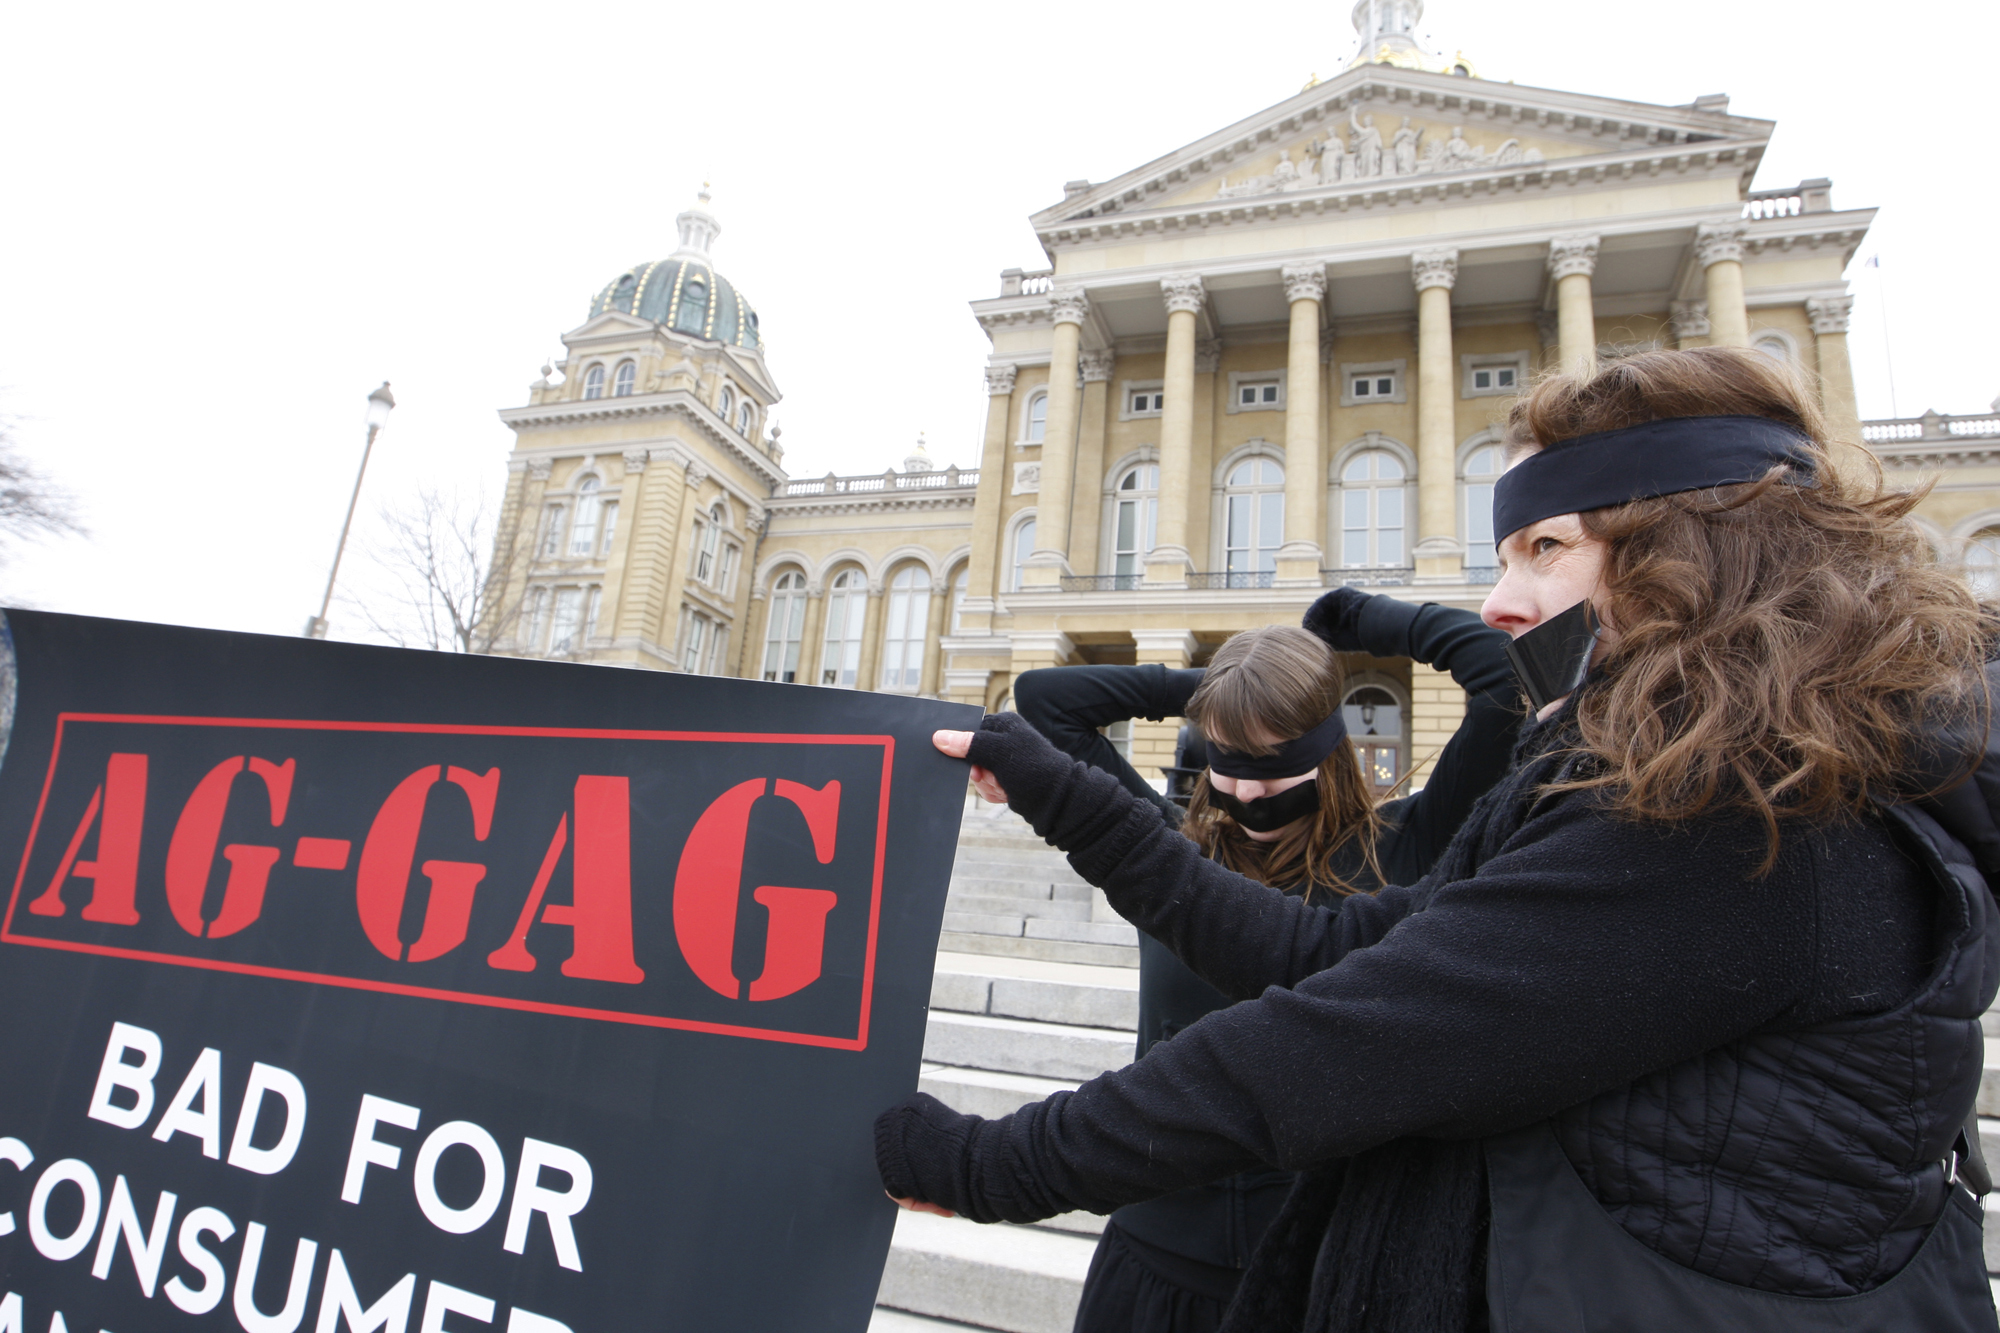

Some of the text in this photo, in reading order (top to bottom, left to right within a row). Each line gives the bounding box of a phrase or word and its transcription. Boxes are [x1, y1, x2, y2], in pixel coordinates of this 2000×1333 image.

[29, 752, 842, 1002] AG-GAG
[0, 1136, 575, 1333] ONSUM
[87, 1021, 593, 1273] BAD FOR
